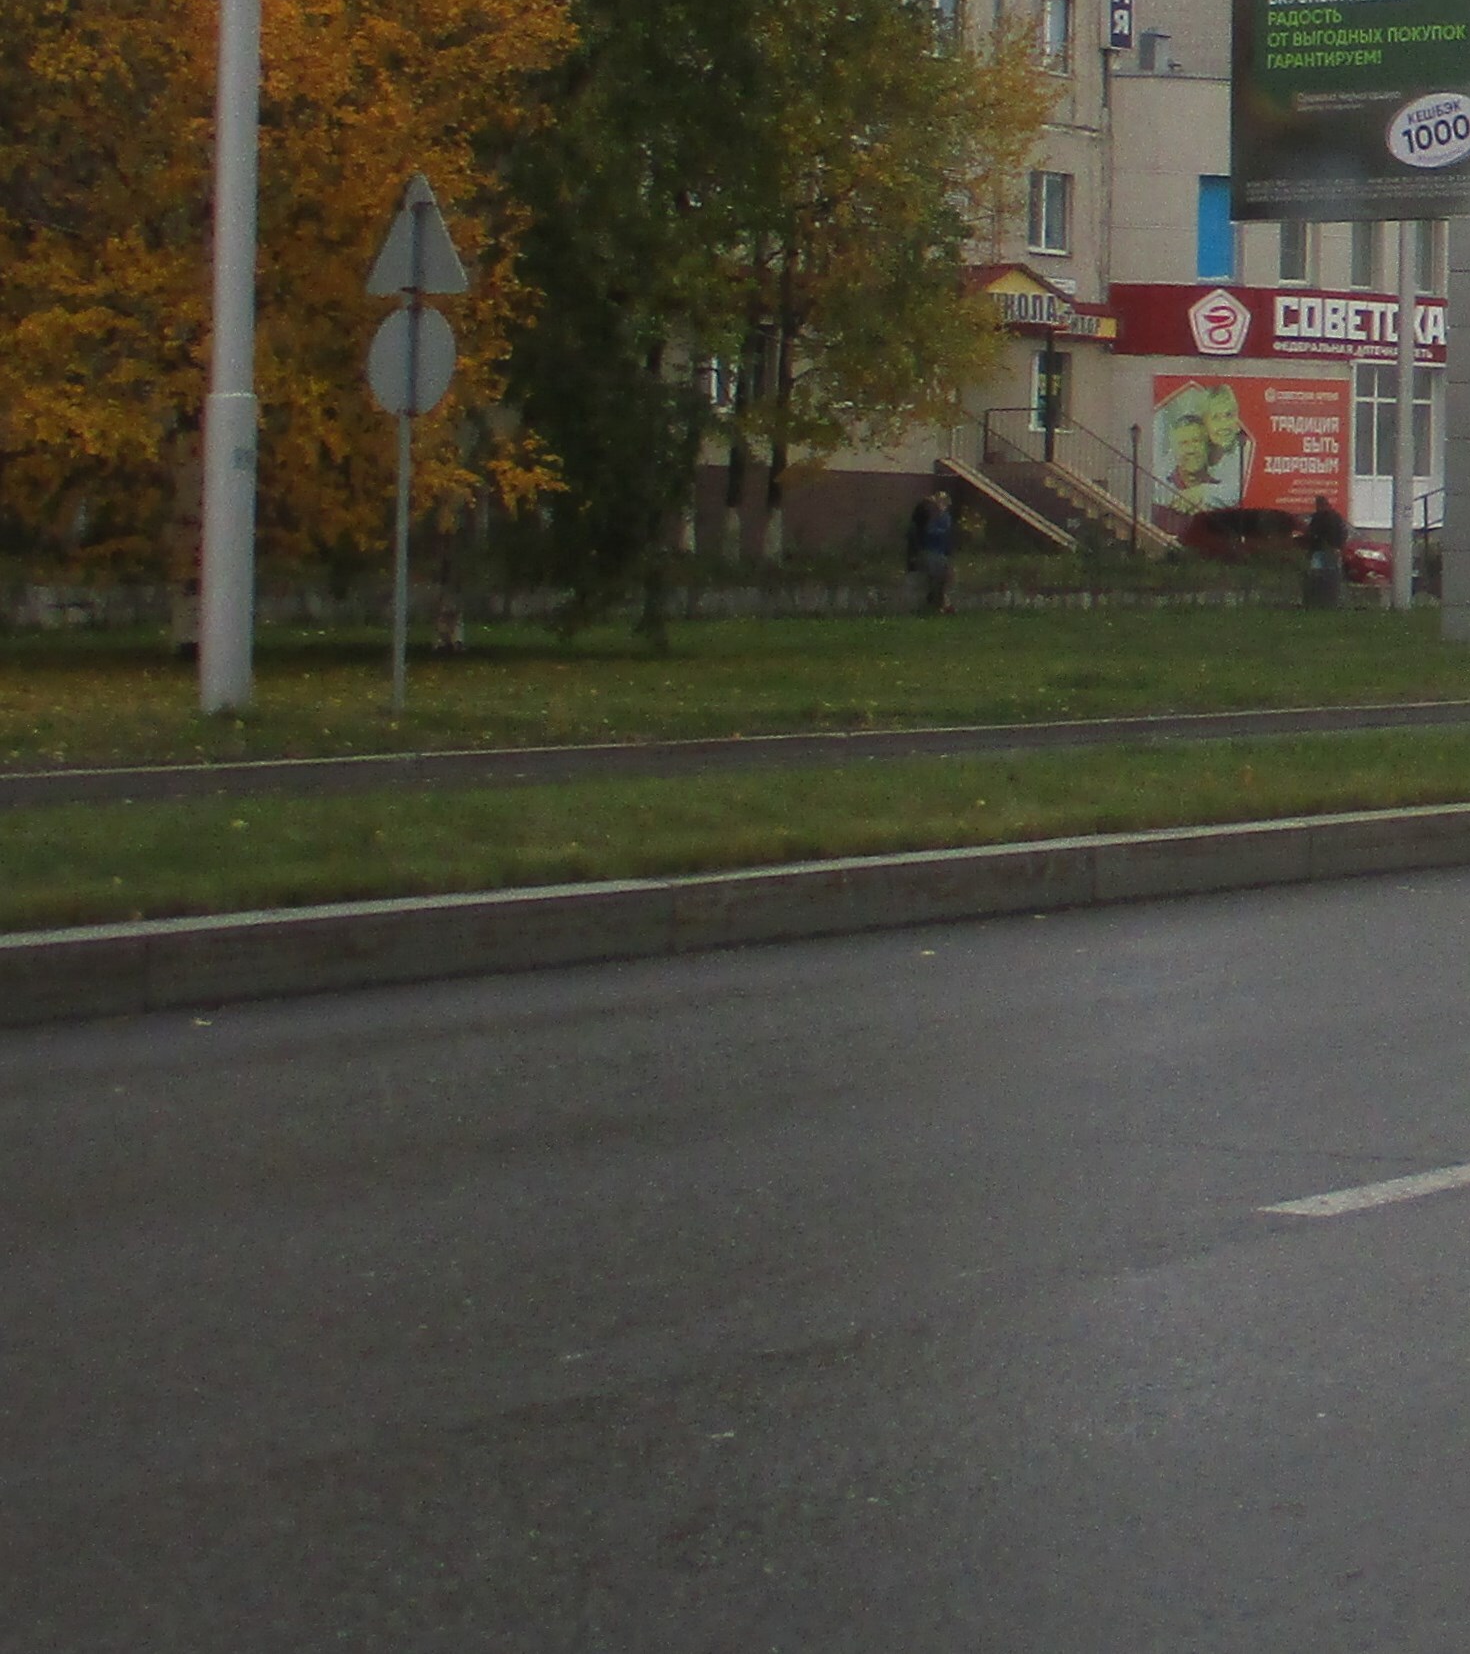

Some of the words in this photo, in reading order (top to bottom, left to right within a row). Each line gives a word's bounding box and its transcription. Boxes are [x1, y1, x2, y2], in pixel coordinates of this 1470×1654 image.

[1268, 8, 1342, 27] РАДОСТЬ
[1267, 31, 1288, 48] ОТ
[1293, 28, 1383, 47] ВЫГОДНЫХ
[1387, 24, 1467, 43] ПОКУПОК
[1267, 50, 1382, 69] ГАРАНТИРУЕМ!
[1407, 100, 1462, 125] КЕШБЭК
[1401, 114, 1470, 153] 1000
[1270, 415, 1340, 434] ТРАДИЦИЯ
[1302, 437, 1340, 453] БЫТЬ
[1264, 456, 1340, 475] ЗДОРОВЫМ
